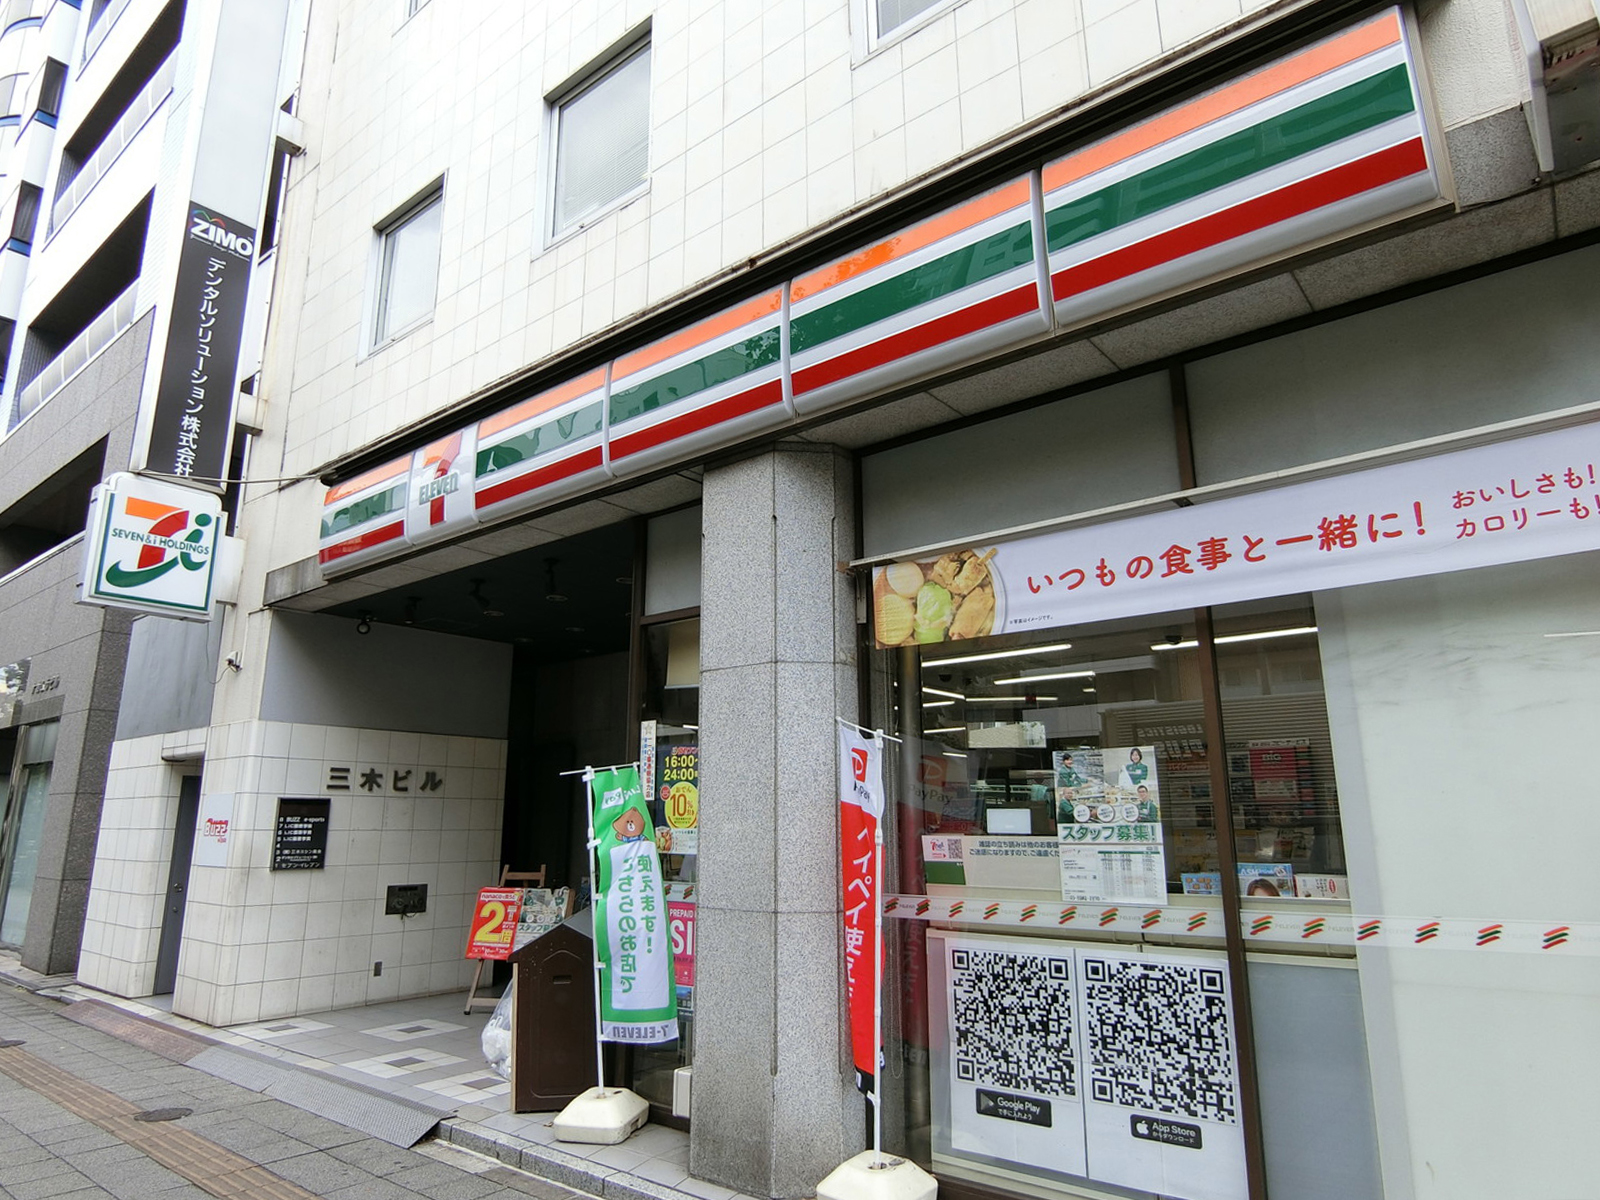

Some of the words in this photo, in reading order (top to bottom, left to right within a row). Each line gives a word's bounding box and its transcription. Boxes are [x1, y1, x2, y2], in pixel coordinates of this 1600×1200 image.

[190, 217, 254, 256] ZIMO
[174, 257, 227, 478] デンタルソリューション株式会社
[159, 538, 210, 555] HOLDINGS
[1027, 501, 1427, 594] いつもの食事と一緒に!
[326, 767, 443, 792] 三木ビル
[1063, 824, 1156, 841] スタッフ募集!
[997, 1097, 1024, 1111] Google
[1025, 1101, 1041, 1115] Play
[1152, 1122, 1169, 1133] App
[1171, 1125, 1196, 1137] Store
